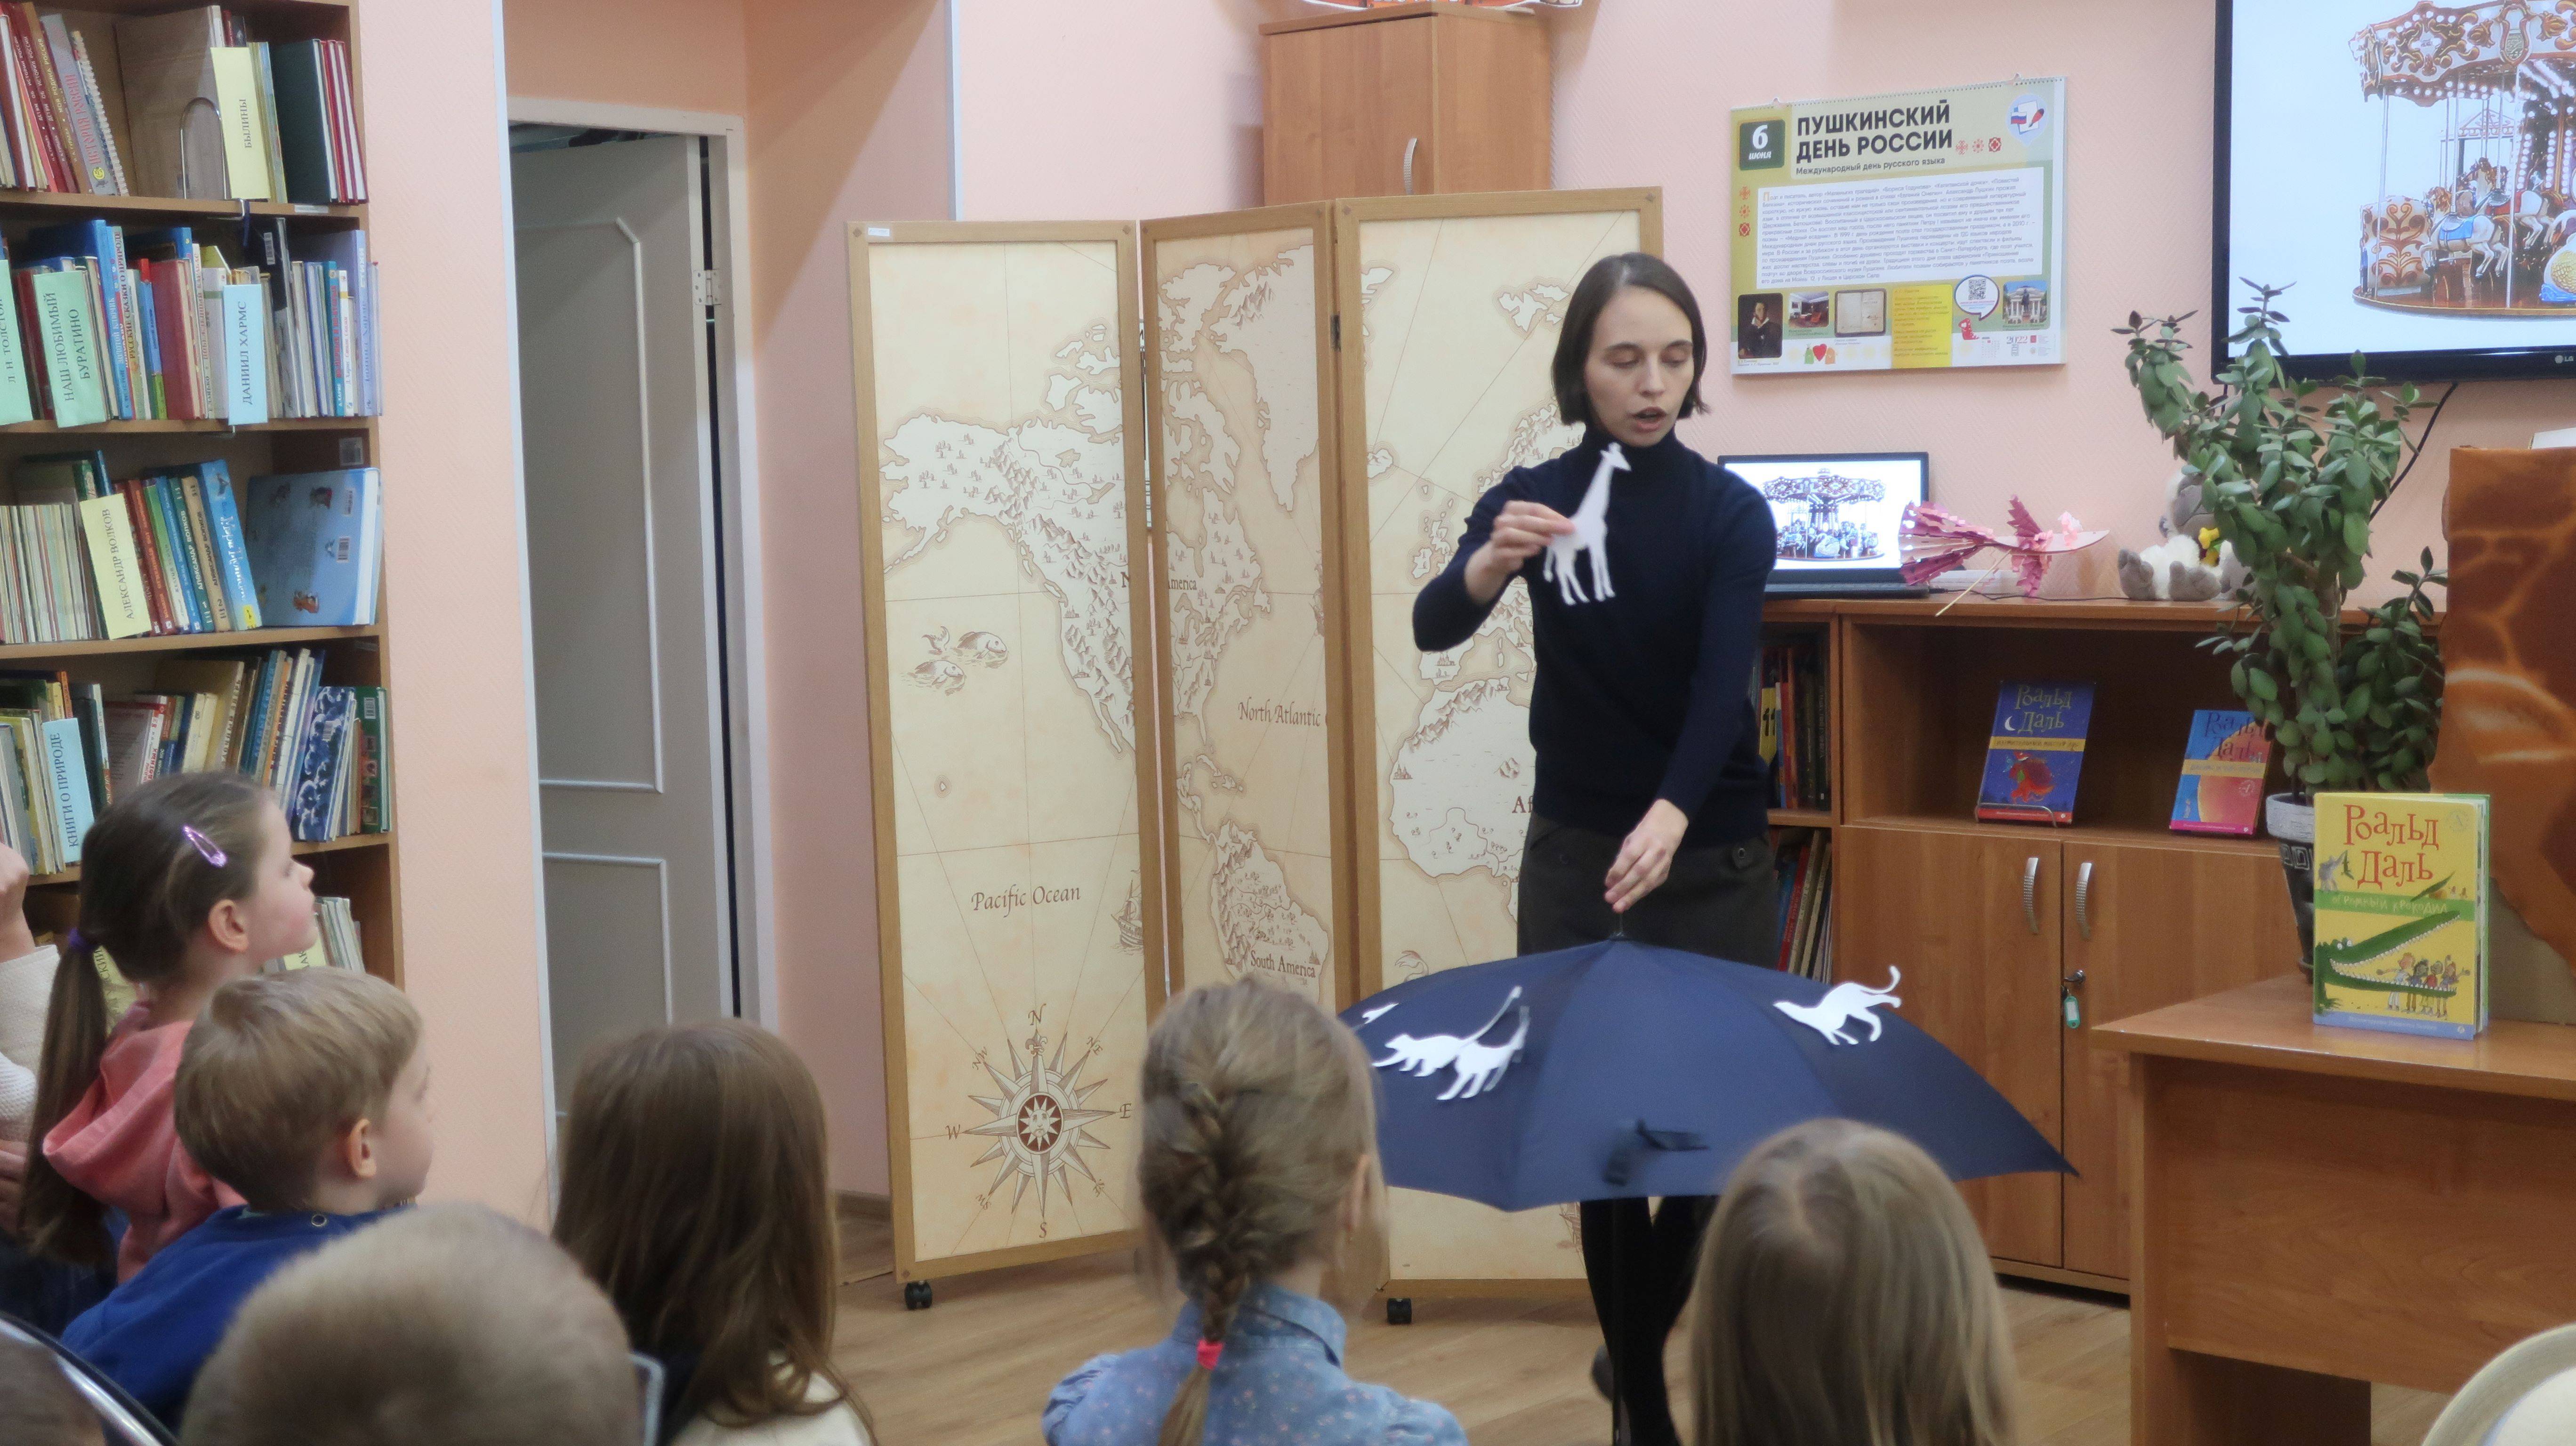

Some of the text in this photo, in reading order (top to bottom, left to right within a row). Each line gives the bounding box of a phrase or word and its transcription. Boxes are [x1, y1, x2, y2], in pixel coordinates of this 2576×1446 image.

[24, 35, 34, 58] РОССИИ
[37, 38, 49, 65] РОССИЯ
[20, 60, 32, 86] ИСТОРИИ
[31, 60, 42, 86] ИСТОРИИ
[46, 67, 58, 96] РОДИНА
[30, 90, 36, 98] ОБ
[40, 90, 46, 99] ОБ
[55, 97, 64, 113] МОЯ
[65, 74, 86, 116] РОССИИ
[34, 103, 43, 121] ДЕТЯМ
[44, 103, 53, 122] ДЕТЯМ
[239, 98, 252, 148] БЫЛИНЫ
[1797, 99, 1950, 137] ПУШКИНСКИЙ
[78, 116, 99, 165] ИСТОРИЯ
[1752, 125, 1768, 149] 6
[1796, 129, 1953, 164] ДЕНЬ РОССИИ
[1748, 150, 1771, 161] июня
[1796, 157, 1946, 176] Международный день русского языка
[113, 231, 126, 273] ПРИРОДЕ
[108, 297, 119, 329] КЛЮЧИК
[121, 284, 131, 318] СКАЗКИ
[44, 291, 74, 402] НАШ ЛЮБИМЫЙ
[69, 308, 90, 379] БУРАТИНО
[112, 331, 124, 364] ЗОЛОТОЙ
[124, 320, 137, 359] РУССКИЕ
[238, 300, 254, 405] ДАНИИЛ ХАРМС
[6, 359, 14, 370] Н.
[179, 510, 205, 590] АЛЕКСАНДР ВОЛКОВ
[197, 511, 219, 586] АЛЕКСАНДР ВОЛКОВ
[103, 509, 134, 620] АЛЕКСАНДР ВОЛКОВ
[2015, 684, 2072, 710] Роальд
[1238, 699, 1321, 727] North Atlantic
[2017, 711, 2065, 734] Даль
[50, 733, 79, 848] КНИГИ О ПРИРОДЕ
[2343, 804, 2439, 851] Роальд
[2357, 850, 2433, 891] Даль
[971, 884, 1081, 918] Pacific Ocean
[1251, 952, 1316, 979] South America
[1028, 1004, 1046, 1025] N
[972, 1046, 988, 1071] NW
[1087, 1036, 1103, 1056] NE
[1120, 1103, 1132, 1119] E
[946, 1125, 961, 1140] W
[1039, 1222, 1047, 1238] S
